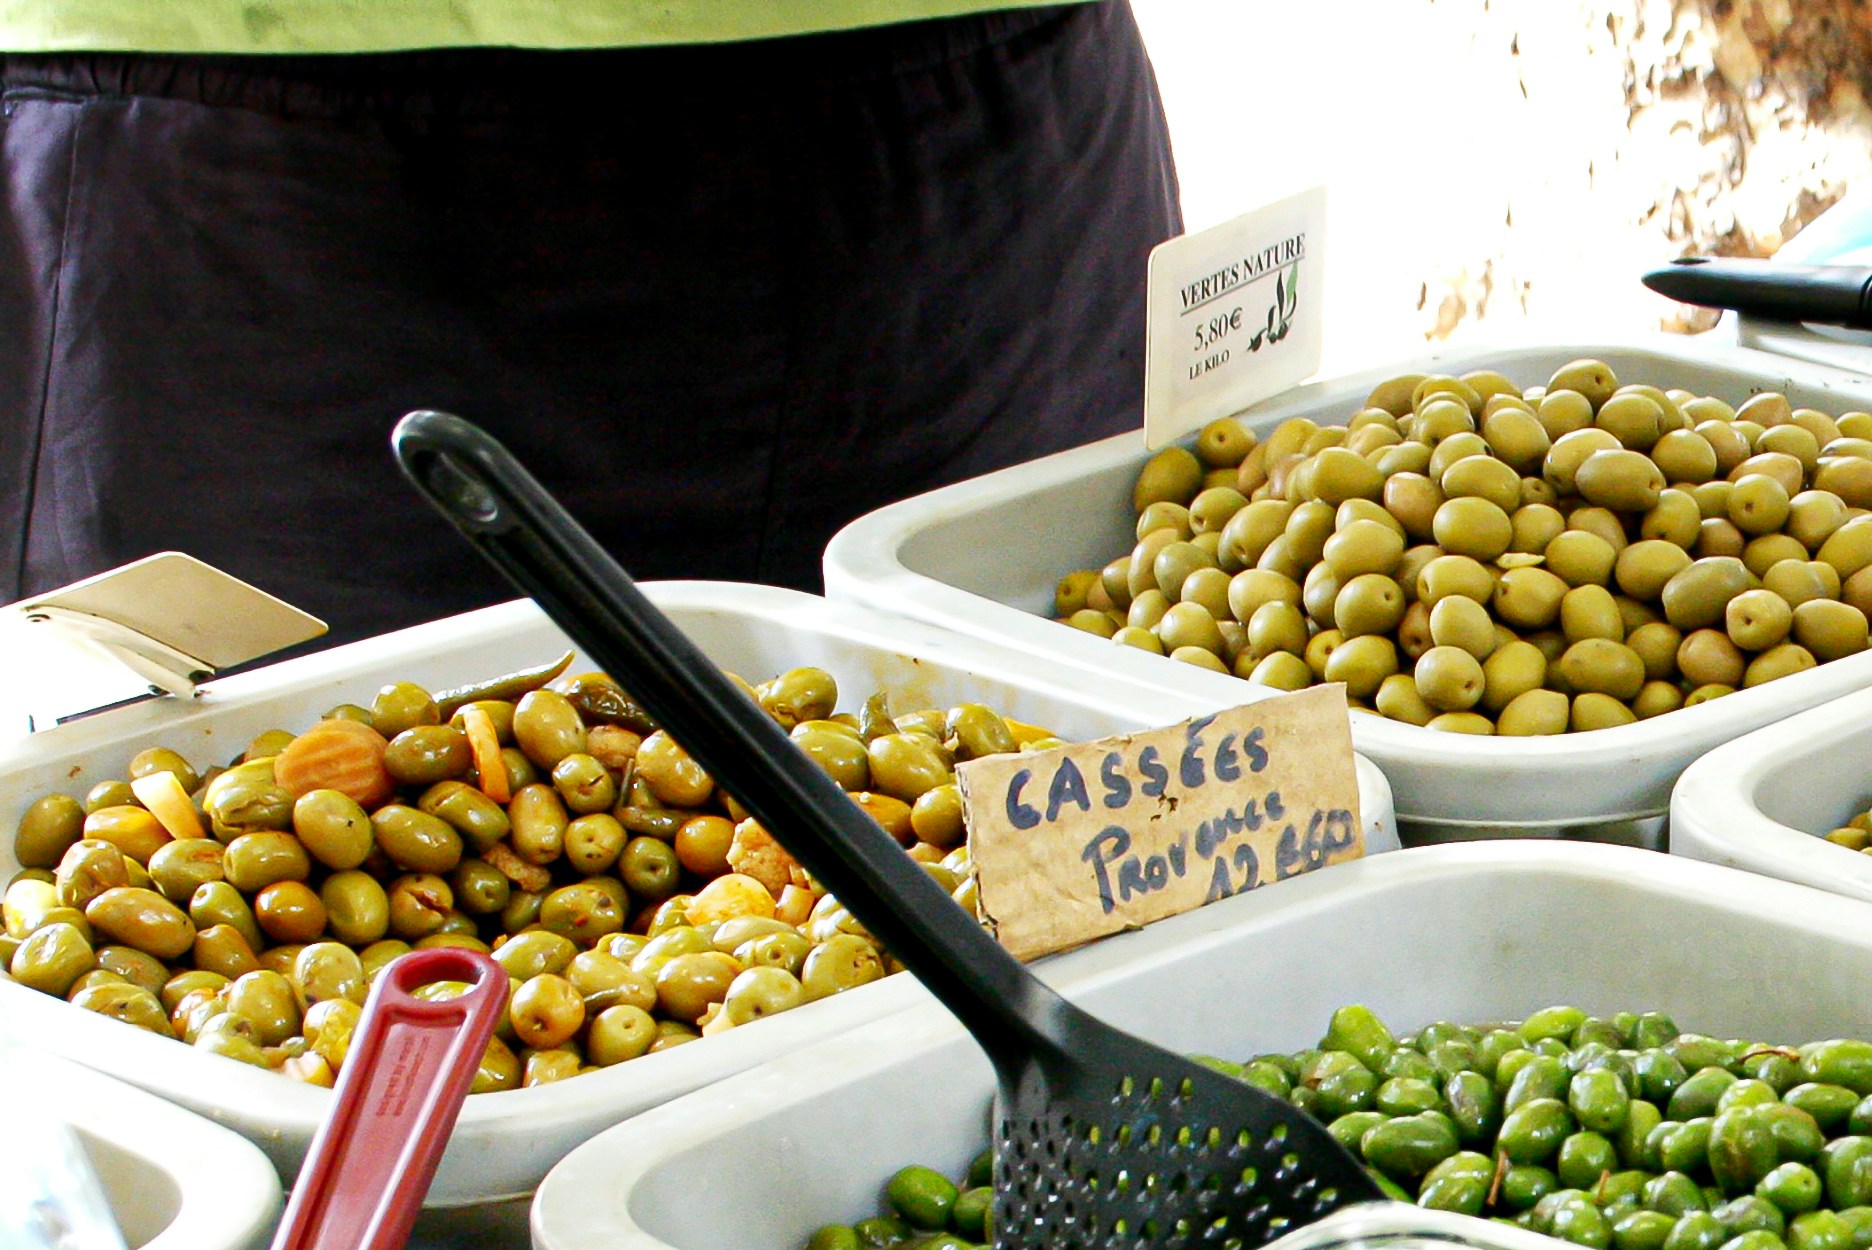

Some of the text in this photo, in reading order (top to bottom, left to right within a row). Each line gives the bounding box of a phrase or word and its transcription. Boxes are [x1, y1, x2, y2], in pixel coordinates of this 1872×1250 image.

[1180, 232, 1307, 309] VERTES NATURE
[1194, 307, 1243, 352] 5,80€
[1189, 349, 1230, 381] LE KILO
